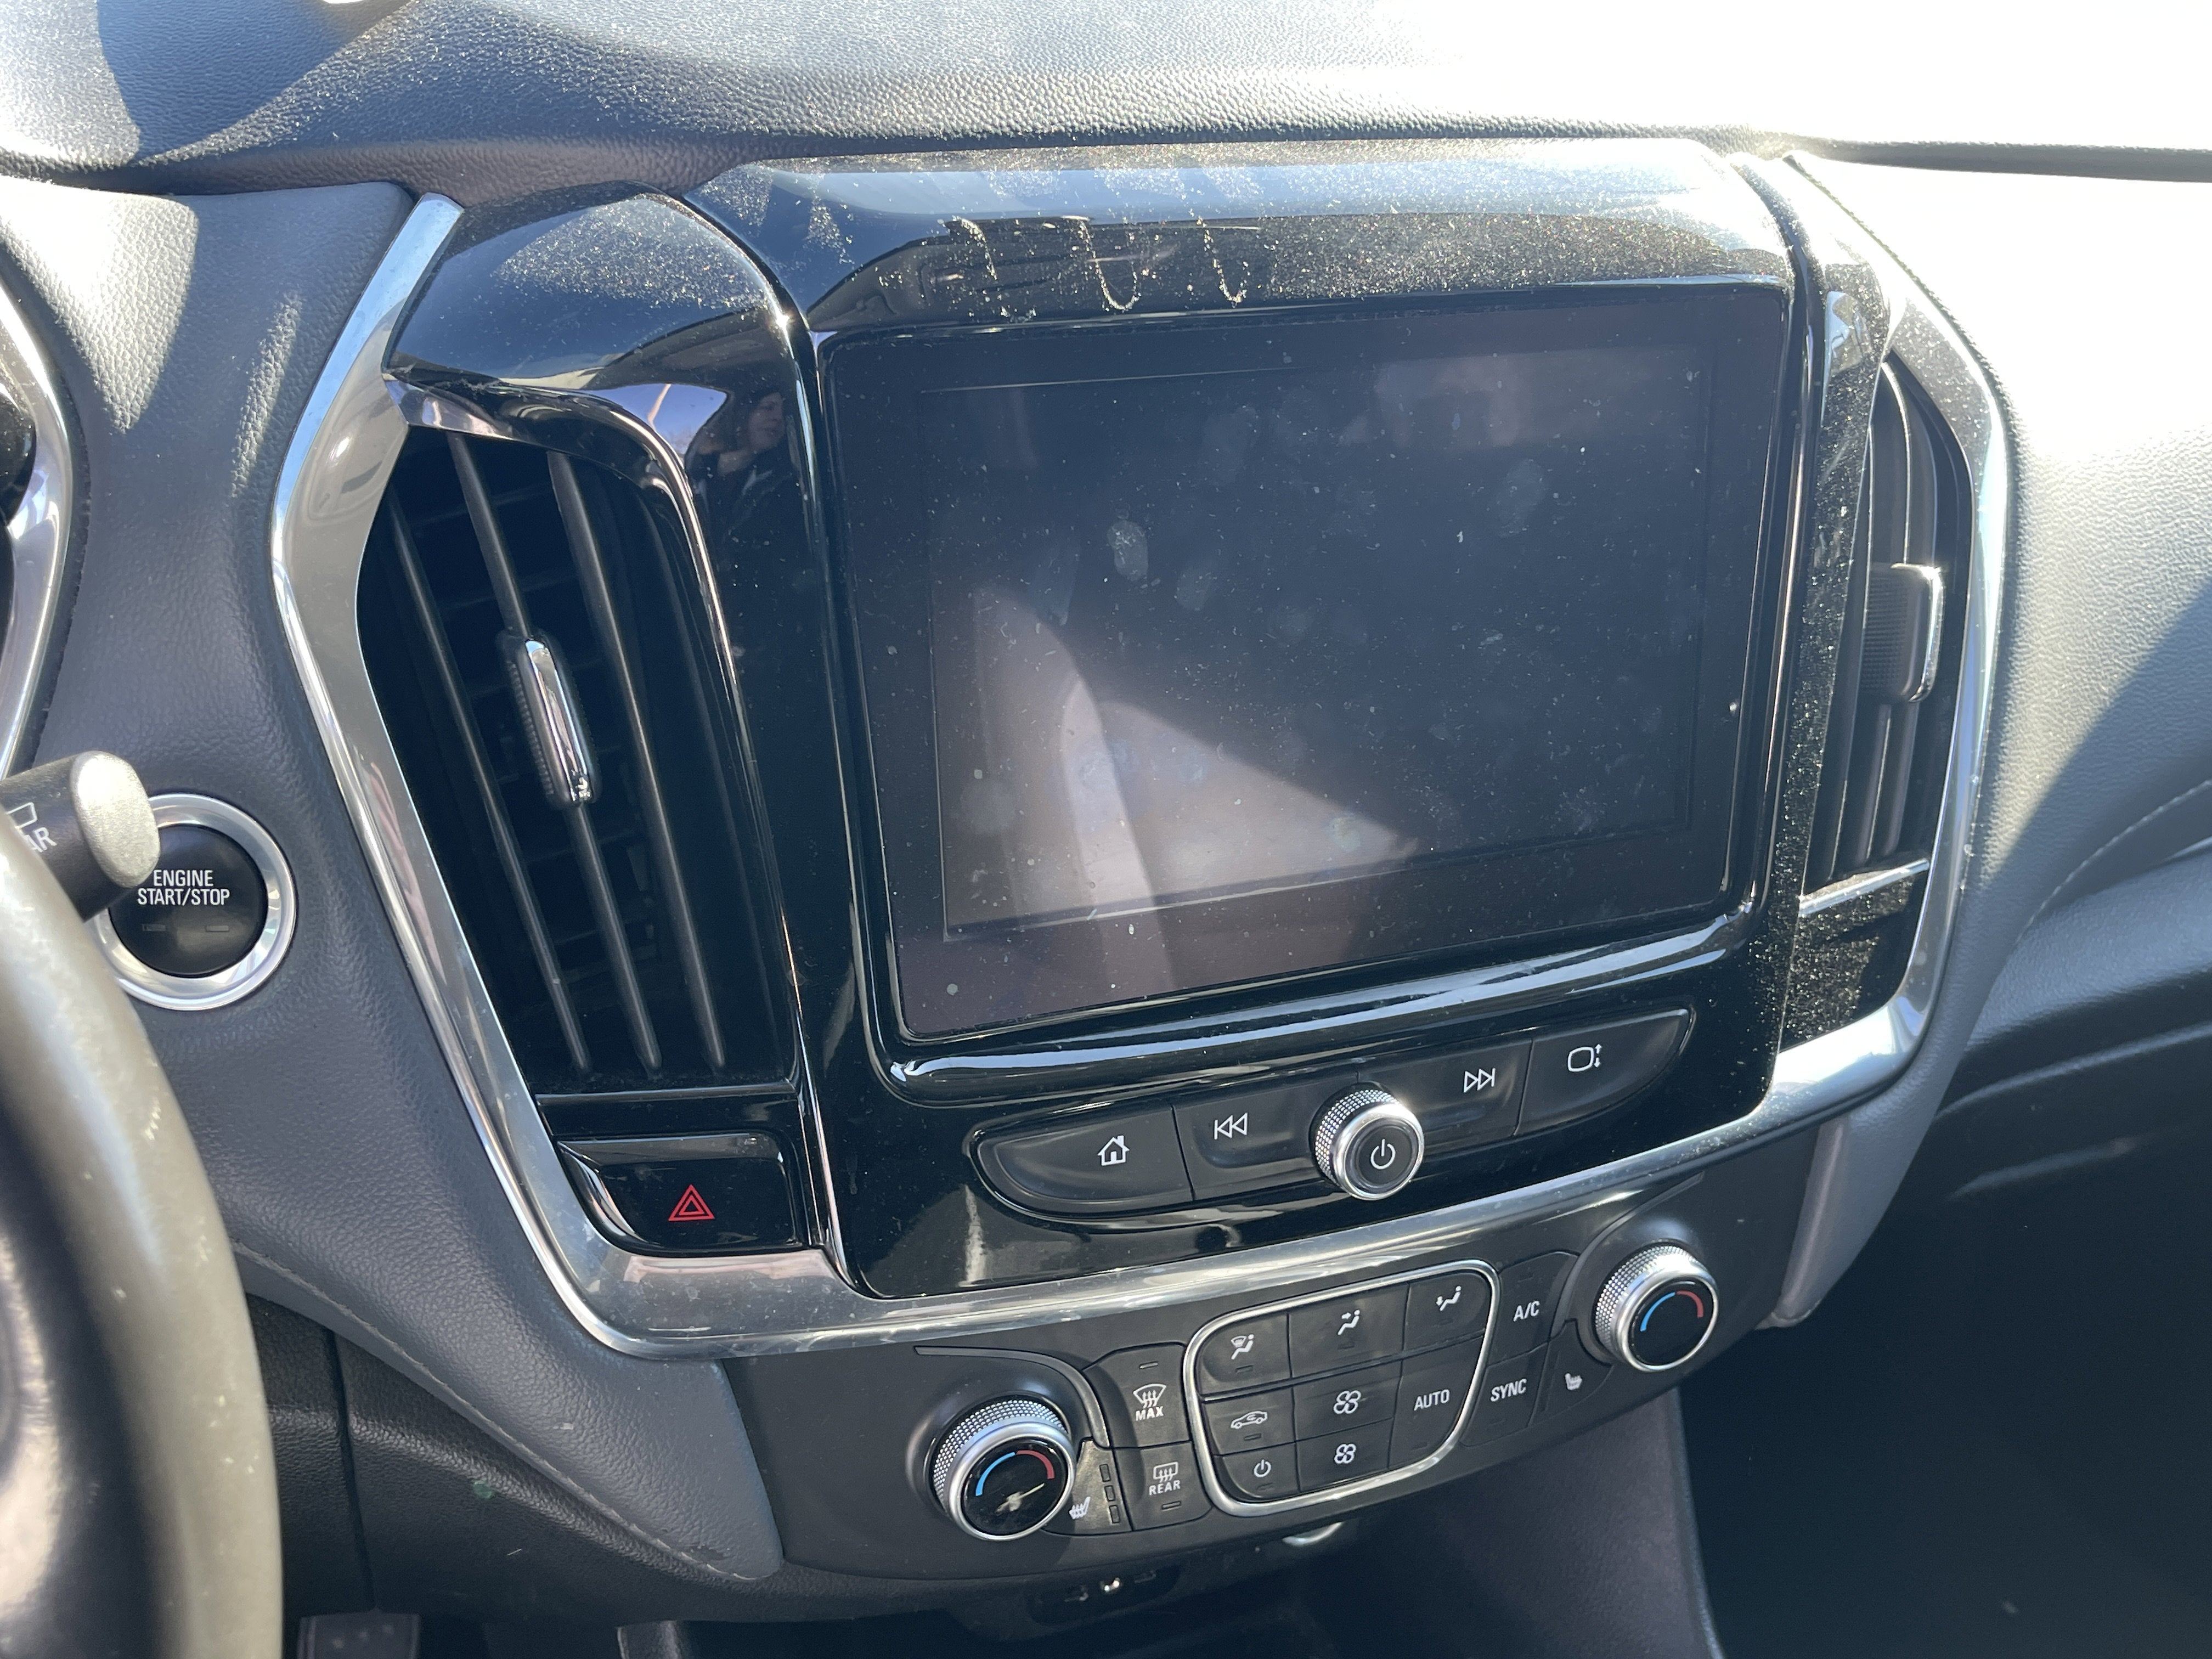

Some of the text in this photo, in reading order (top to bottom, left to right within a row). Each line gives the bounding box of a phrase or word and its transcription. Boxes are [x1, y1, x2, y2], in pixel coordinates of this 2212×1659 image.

[153, 869, 214, 887] ENGINE
[137, 887, 230, 906] START/STOP
[1513, 1300, 1540, 1322] A/C
[1490, 1378, 1527, 1402] SYNC
[1413, 1389, 1451, 1411] AUTO
[1135, 1406, 1164, 1421] MAX
[1149, 1480, 1181, 1496] REAR
